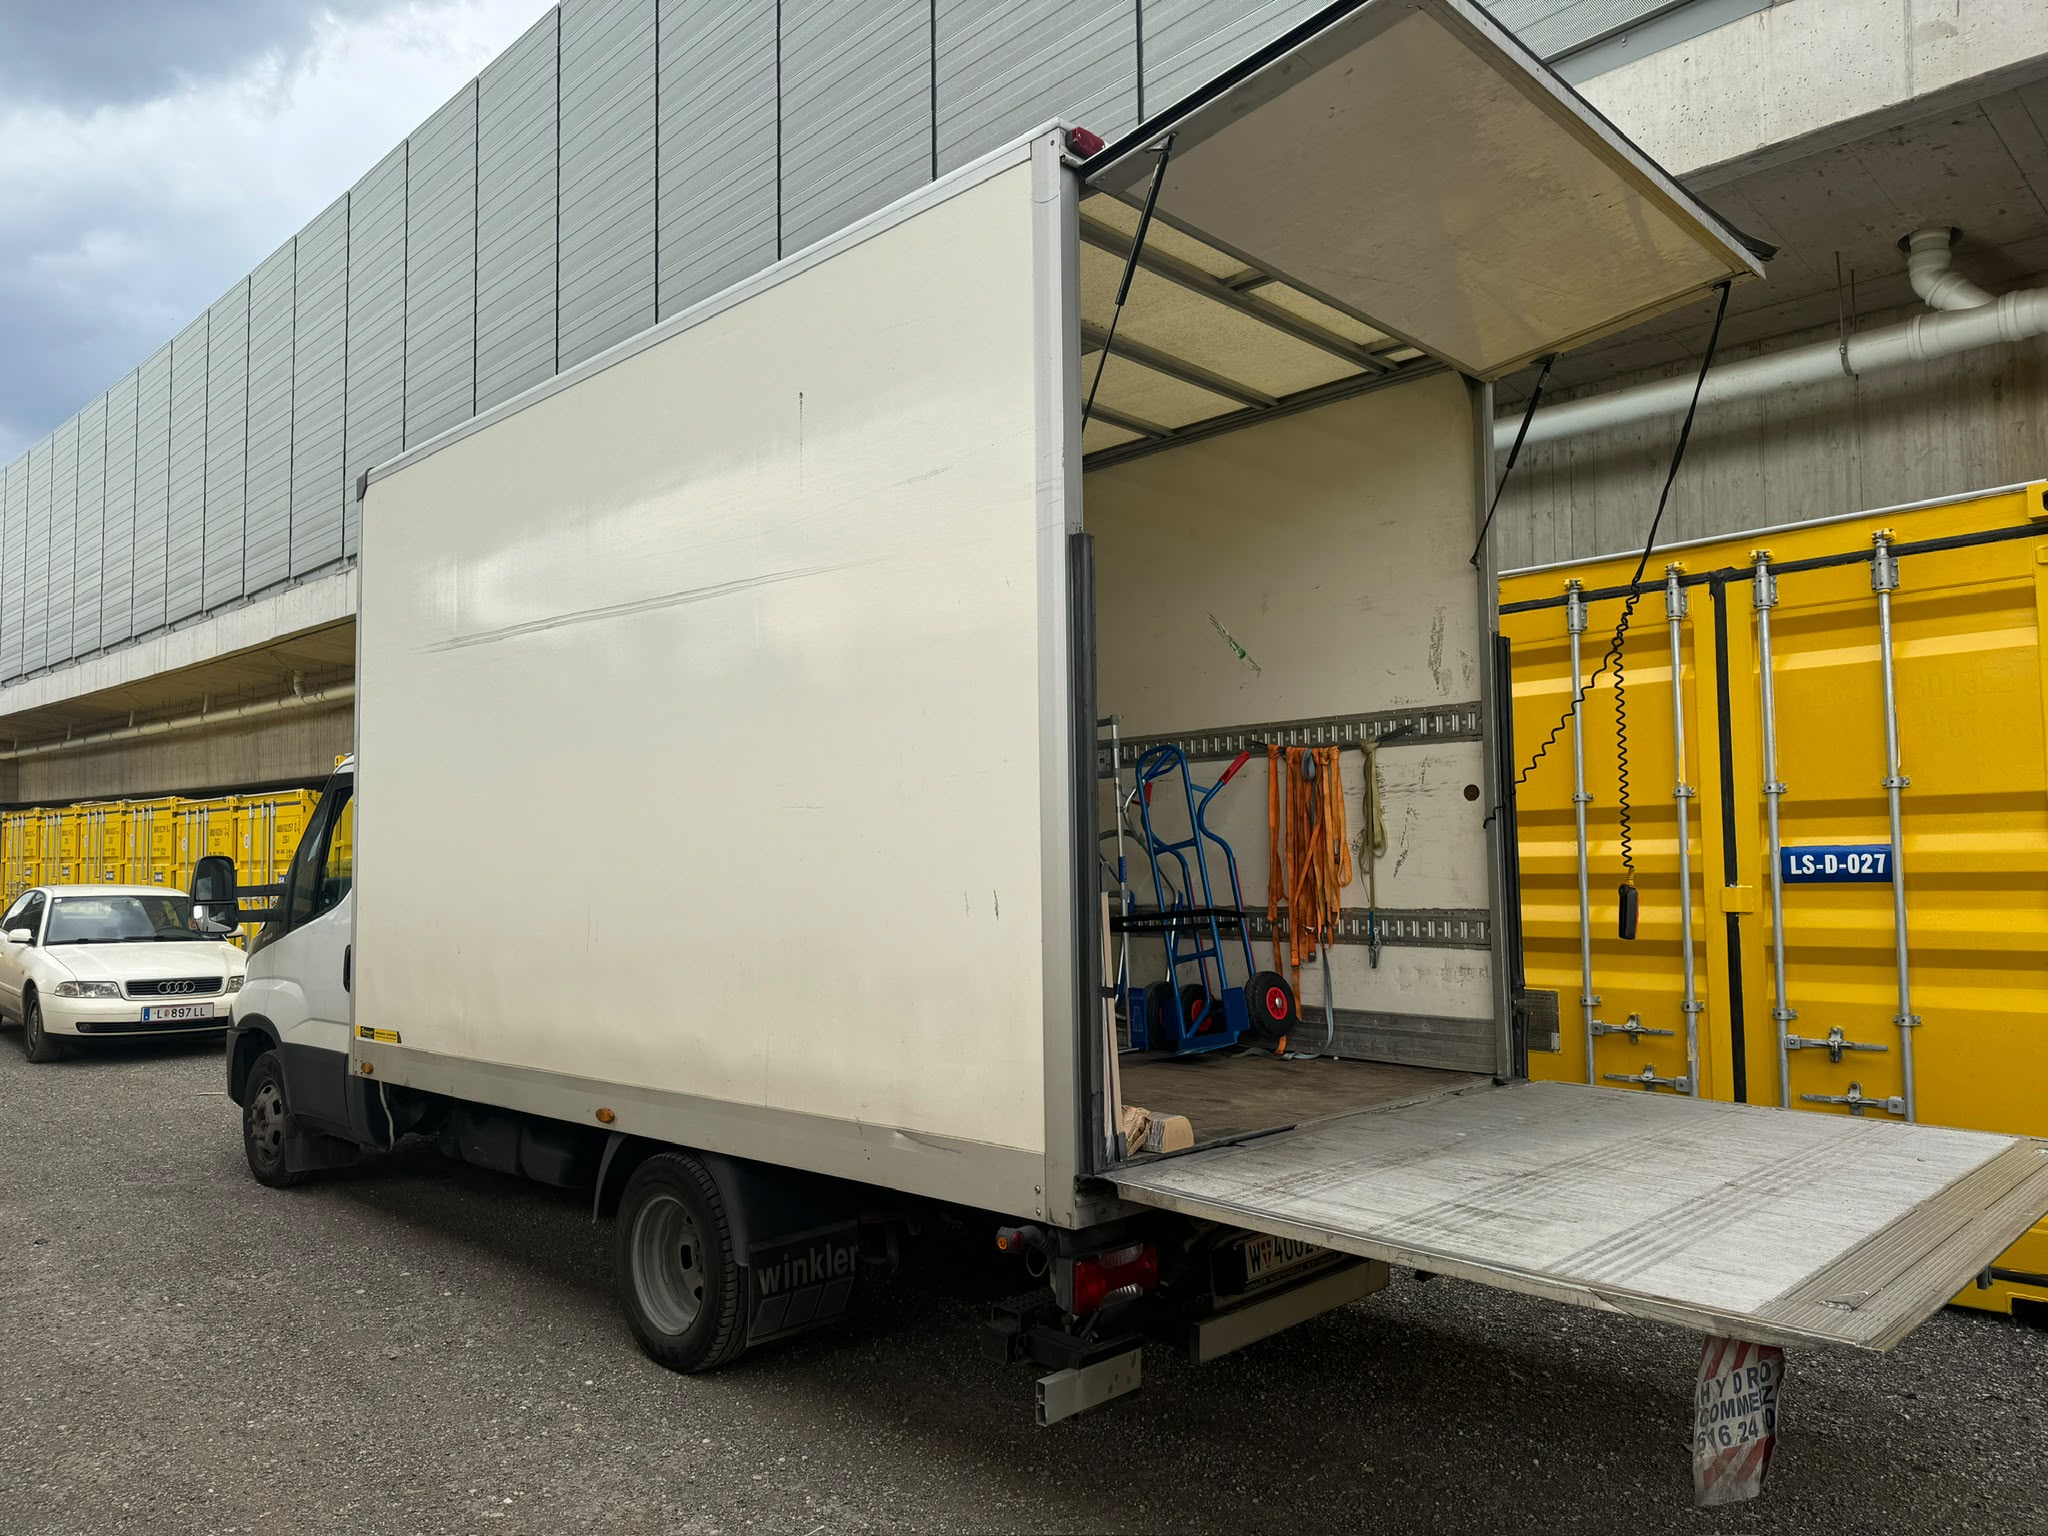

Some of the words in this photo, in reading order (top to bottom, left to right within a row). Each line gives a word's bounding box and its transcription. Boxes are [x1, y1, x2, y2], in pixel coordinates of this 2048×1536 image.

[1789, 853, 1887, 875] LS-D-027
[156, 1009, 163, 1019] L
[171, 1008, 192, 1018] 897
[193, 1007, 205, 1017] LL
[757, 1242, 859, 1296] winkler
[1248, 1242, 1261, 1274] W
[1700, 1361, 1771, 1406] HYDRO
